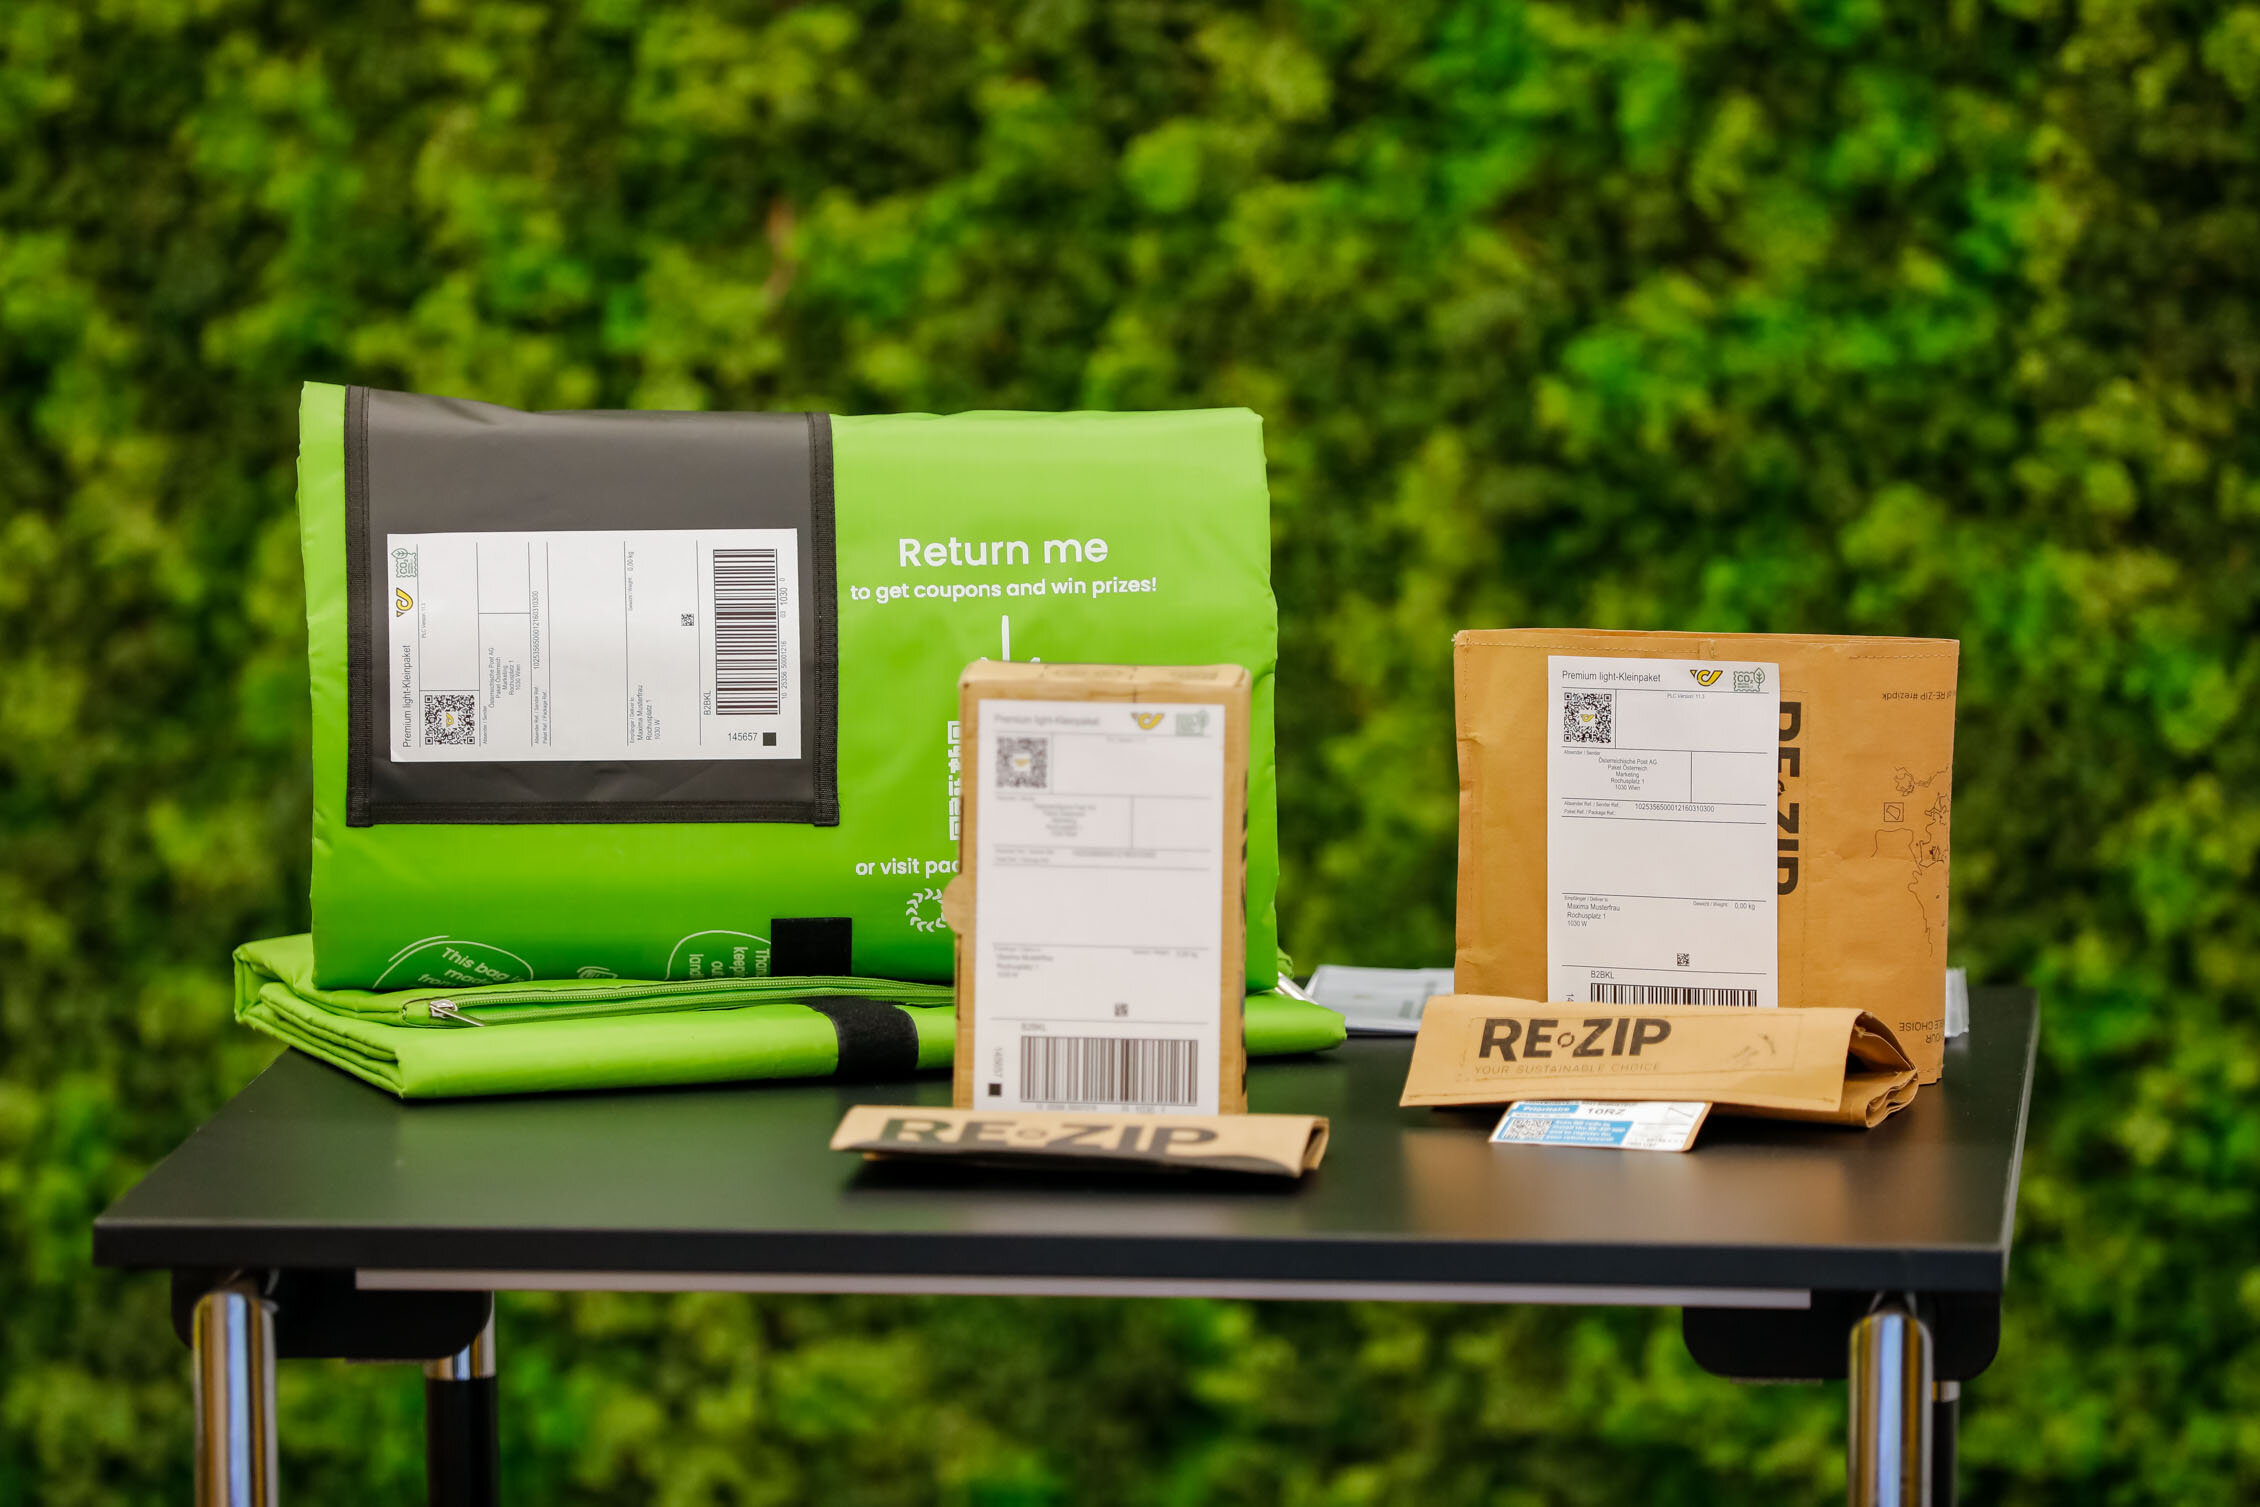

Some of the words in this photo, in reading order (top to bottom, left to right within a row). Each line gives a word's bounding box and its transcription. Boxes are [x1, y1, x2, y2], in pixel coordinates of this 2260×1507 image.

[899, 537, 1029, 567] Return
[1044, 537, 1108, 564] me
[779, 587, 788, 606] 1030
[850, 584, 871, 600] to
[875, 582, 909, 604] get
[914, 582, 1001, 602] coupons
[1006, 579, 1046, 596] and
[1051, 577, 1086, 594] win
[1092, 576, 1157, 599] prizes!
[402, 645, 413, 708] light-Kleinpaket
[780, 671, 788, 689] 25356
[1562, 670, 1597, 680] Premium
[1600, 672, 1661, 683] light-Kleinpaket
[780, 692, 787, 700] 10
[1881, 692, 1918, 701] #rezipdk
[703, 690, 712, 716] B2BKL
[402, 710, 412, 748] Premium
[645, 704, 653, 741] Rochusplatz
[727, 732, 758, 741] 145657
[1610, 777, 1640, 785] Rochusplatz
[856, 860, 876, 876] or
[880, 857, 920, 875] visit
[1567, 902, 1589, 910] Maxima
[1748, 903, 1755, 911] kg
[1567, 912, 1601, 920] Rochusplatz
[442, 946, 475, 969] This
[474, 962, 511, 983] bag
[1591, 970, 1614, 979] B2BKL
[1898, 1021, 1933, 1032] CHOISE
[1475, 1063, 1511, 1075] YOUR
[1611, 1062, 1660, 1073] CHOICE
[1588, 1108, 1626, 1116] 10RZ
